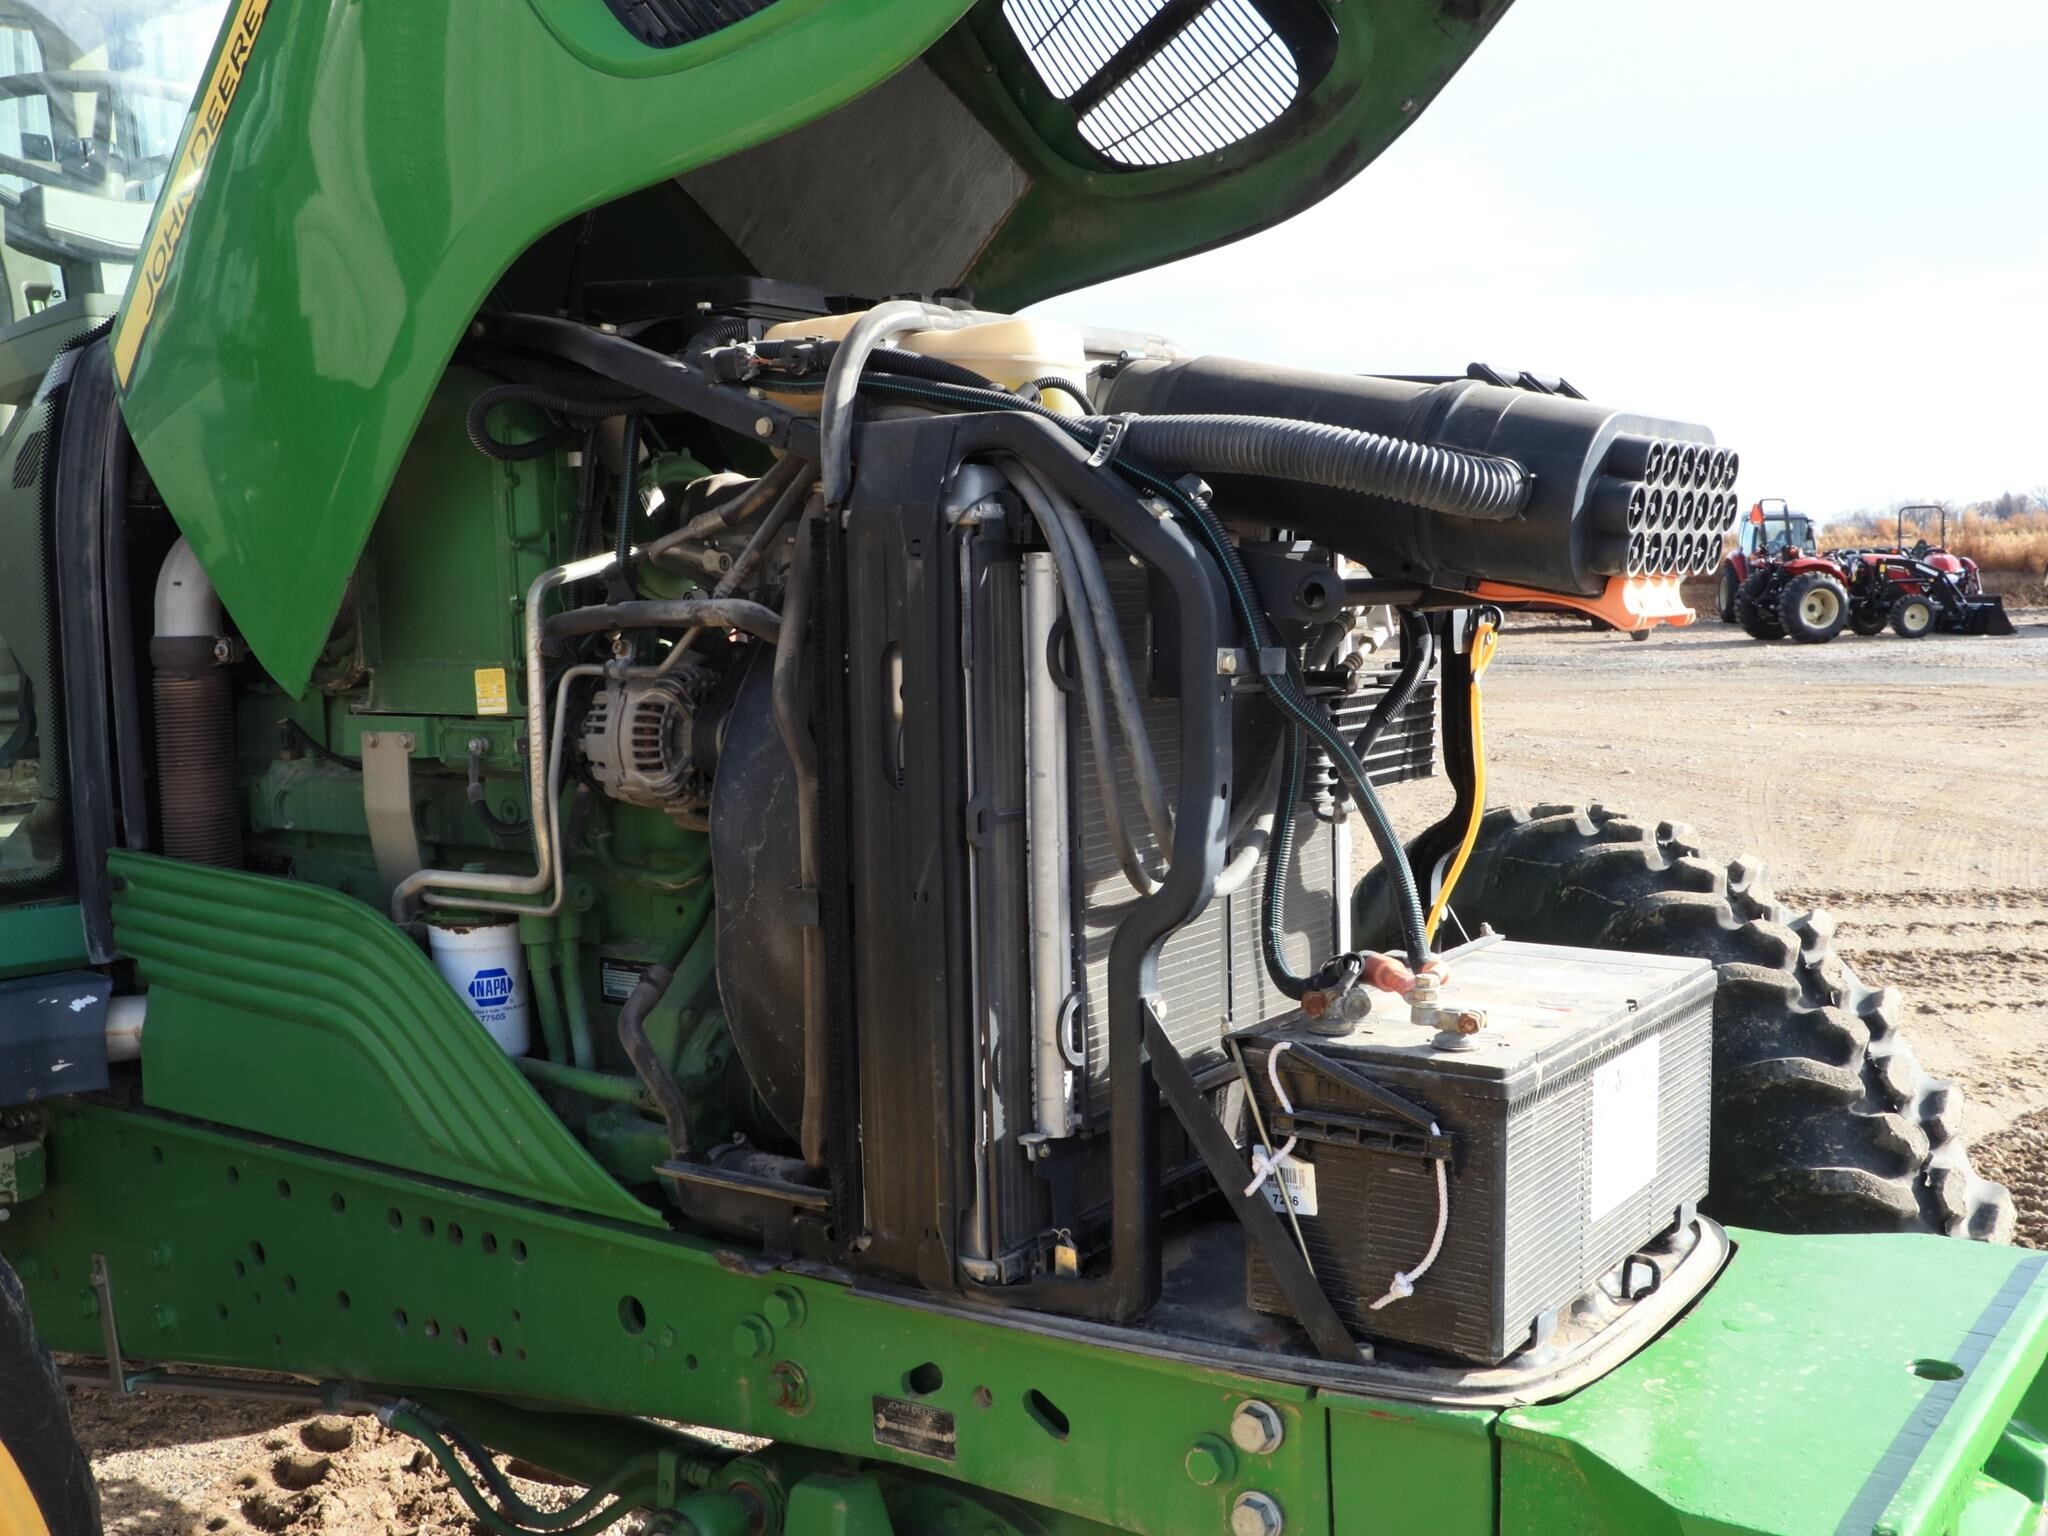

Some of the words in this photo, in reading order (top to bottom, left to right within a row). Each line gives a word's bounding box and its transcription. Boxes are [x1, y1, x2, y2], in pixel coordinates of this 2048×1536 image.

[145, 172, 201, 316] JOHN
[188, 0, 262, 169] DEERE
[475, 977, 508, 998] NAPA
[1272, 1193, 1299, 1206] 726
